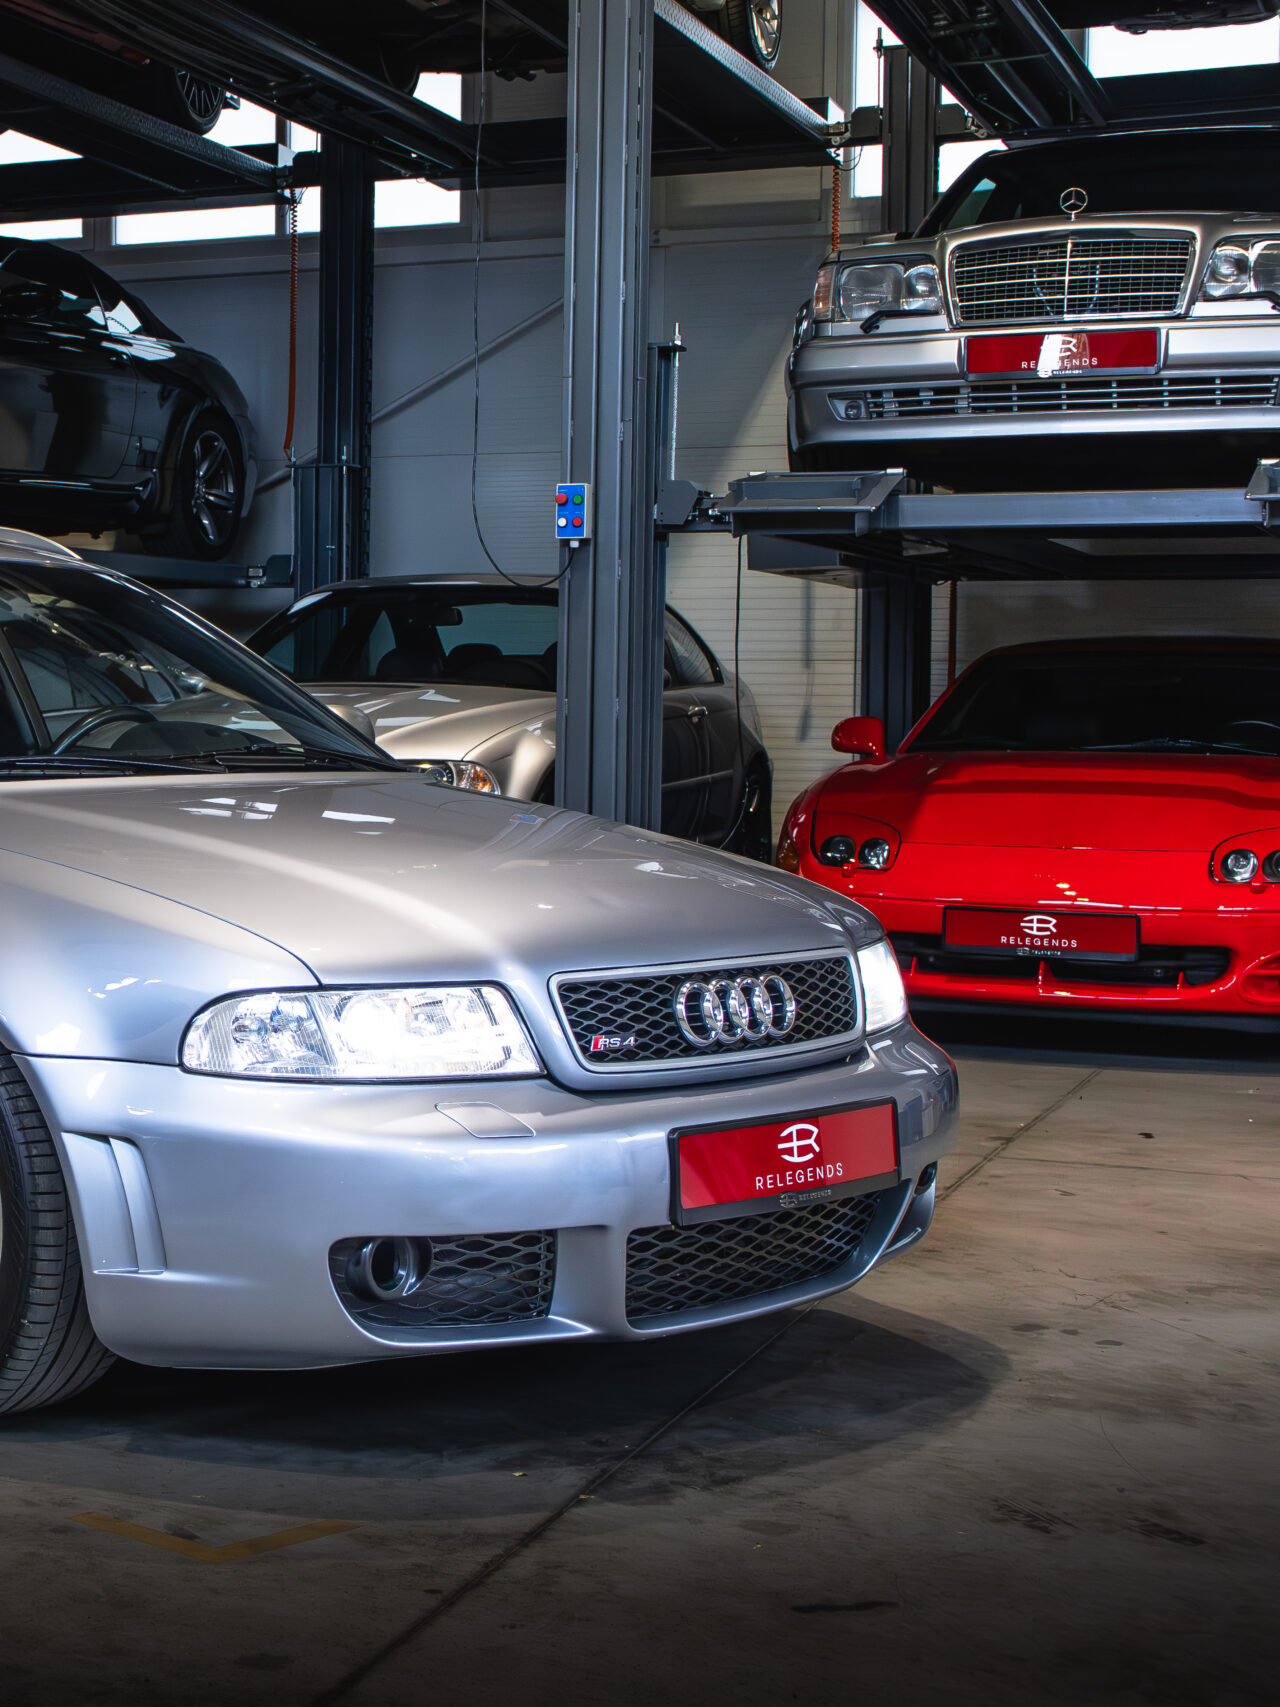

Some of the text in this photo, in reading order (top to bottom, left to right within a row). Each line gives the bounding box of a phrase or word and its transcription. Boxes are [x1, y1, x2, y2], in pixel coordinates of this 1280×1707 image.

[1021, 357, 1099, 369] REENDS
[1000, 935, 1078, 948] RELEGENDS
[755, 1162, 843, 1191] RELEGENDS
